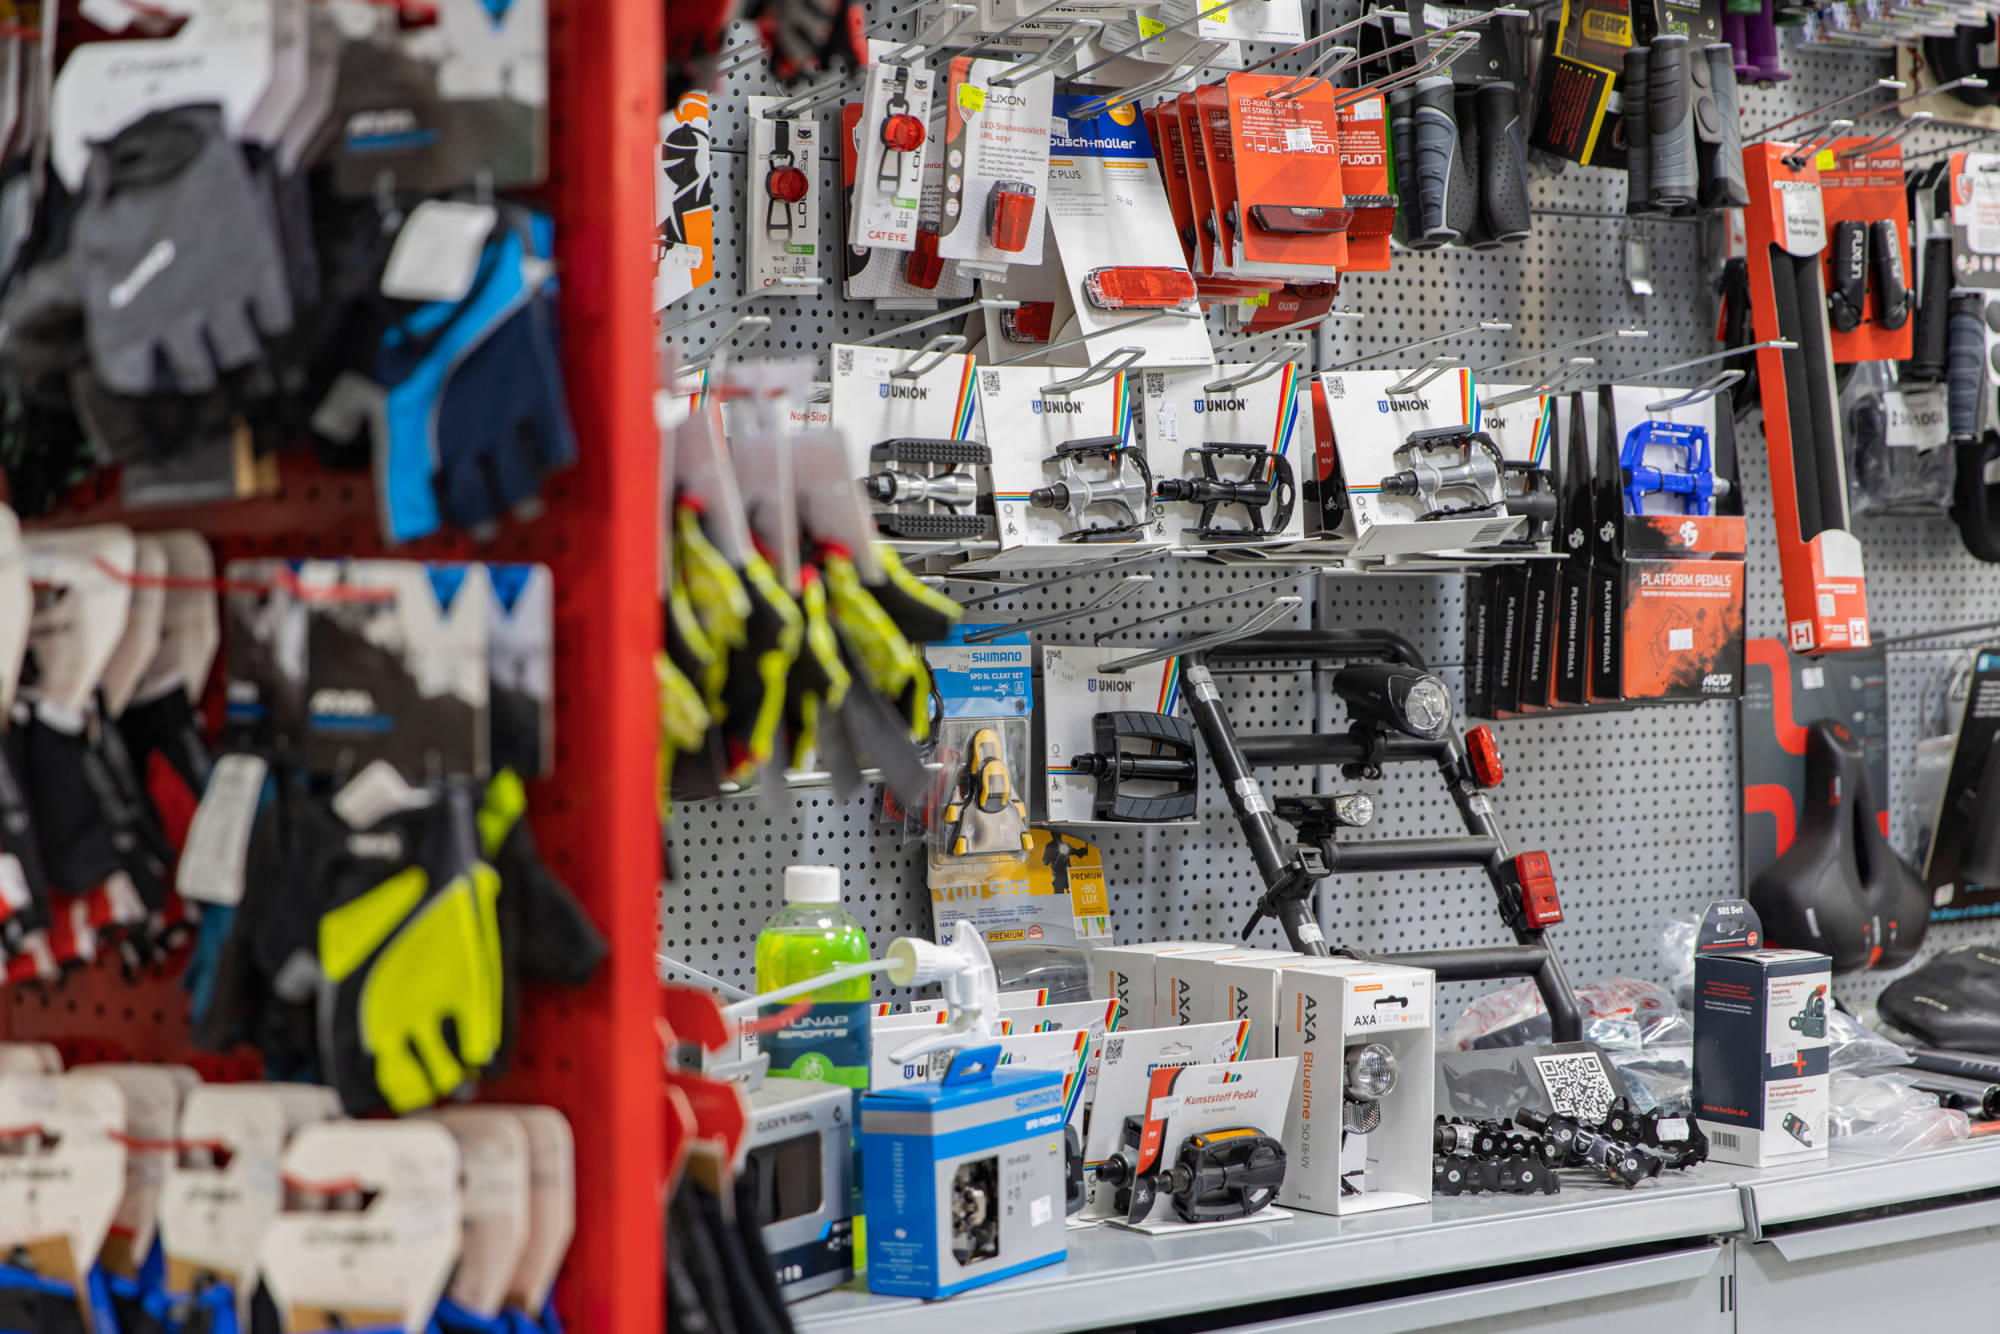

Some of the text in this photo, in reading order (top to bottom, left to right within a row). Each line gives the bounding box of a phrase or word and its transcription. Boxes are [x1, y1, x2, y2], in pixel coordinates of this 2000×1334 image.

[1341, 154, 1382, 165] FUXON
[1058, 170, 1081, 180] PLUS
[868, 230, 908, 243] CATEYE
[891, 385, 927, 400] UNION
[1045, 401, 1082, 413] UNION
[1207, 399, 1245, 412] UNION
[1390, 400, 1429, 412] UNION
[1484, 418, 1506, 429] ION
[1641, 573, 1731, 587] PLATFORM PEDALS
[1567, 586, 1579, 679] PLATFORM PEDALS
[1603, 580, 1612, 673] PLATFORM PEDALS
[1531, 590, 1545, 681] PLATFORM PEDALS
[971, 651, 1022, 662] SHIMANO
[1099, 680, 1132, 692] UNION
[1071, 872, 1102, 881] PREMIUM
[989, 880, 1030, 898] SEE
[1081, 894, 1099, 905] LUX
[989, 930, 1023, 940] PREMIUM
[1117, 972, 1129, 1019] AXA
[1178, 979, 1190, 1026] AXA
[1236, 987, 1248, 1019] AX
[1304, 994, 1317, 1044] AXA
[1354, 1014, 1377, 1026] AXA
[1302, 1051, 1314, 1120] Blueline
[1015, 1089, 1062, 1112] SHIMANO
[1184, 1089, 1259, 1105] Kunststoff Pedal
